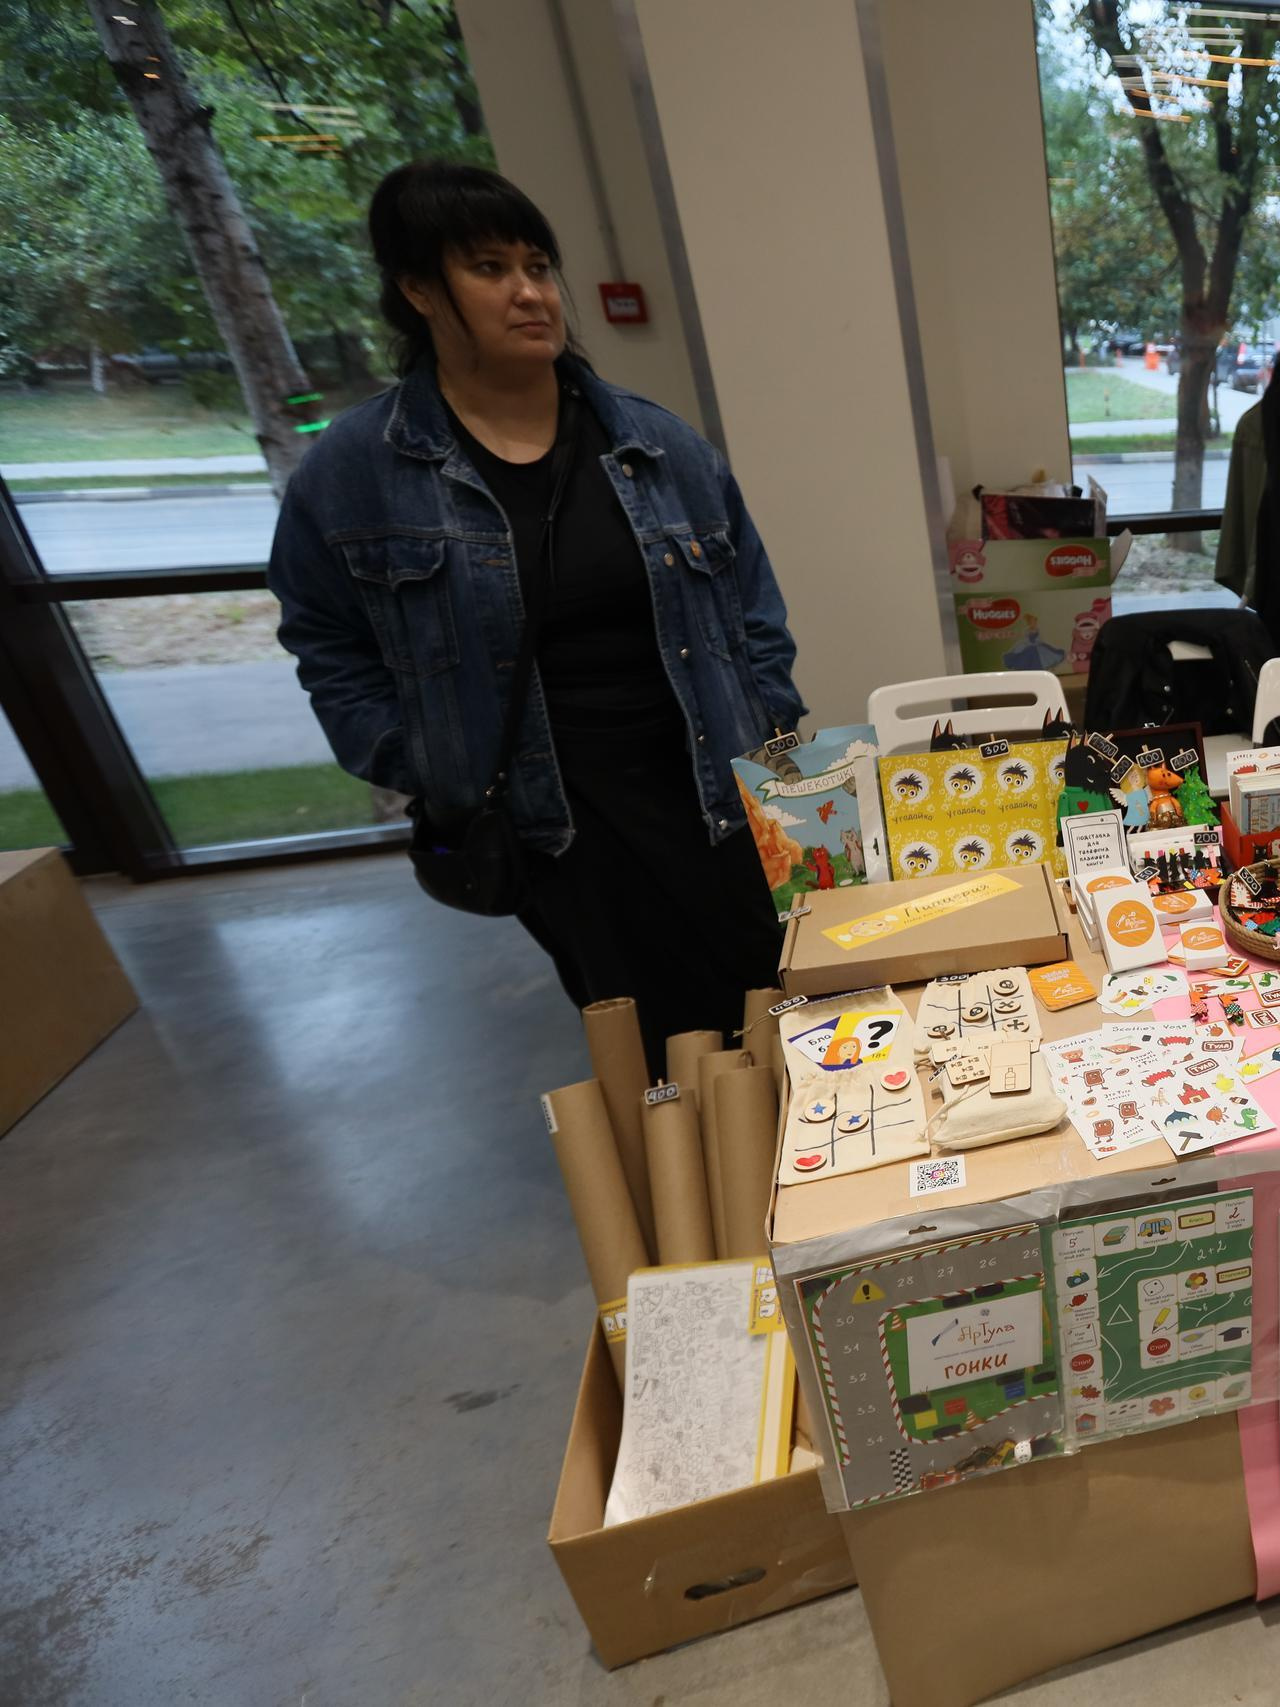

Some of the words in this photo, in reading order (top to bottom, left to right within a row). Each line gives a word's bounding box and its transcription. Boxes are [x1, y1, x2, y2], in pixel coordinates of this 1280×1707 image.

[972, 609, 1016, 620] HUGGIES
[769, 737, 796, 753] 300
[984, 743, 1007, 755] 300
[1139, 752, 1160, 766] 400
[1196, 832, 1219, 844] 200
[1139, 868, 1154, 880] 50
[1241, 870, 1258, 891] 500
[808, 1034, 832, 1046] Бла
[648, 1086, 676, 1102] 400
[1023, 1247, 1039, 1259] 25
[979, 1257, 997, 1269] 26
[937, 1266, 954, 1279] 27
[896, 1276, 914, 1288] 28
